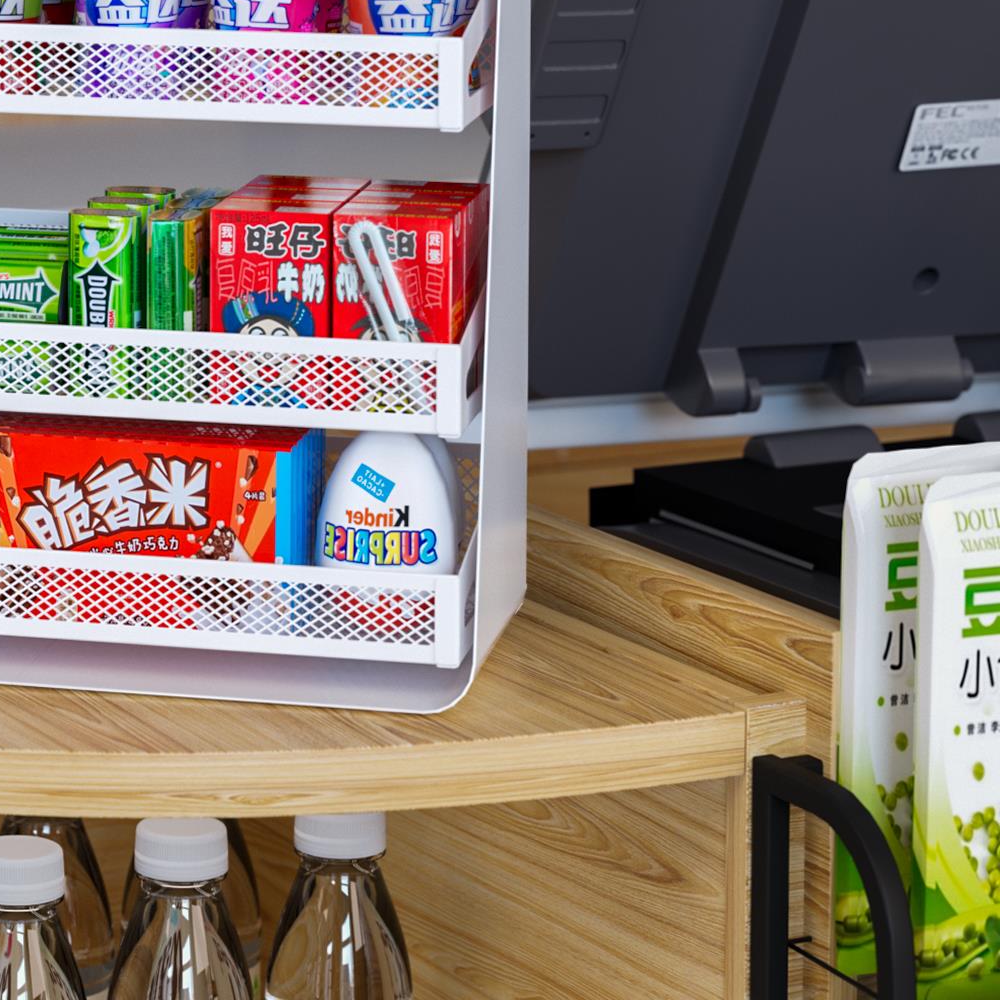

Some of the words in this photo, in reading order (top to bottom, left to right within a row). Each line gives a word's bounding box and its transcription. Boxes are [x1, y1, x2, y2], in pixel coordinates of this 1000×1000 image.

[245, 222, 326, 259] 旺仔
[87, 274, 109, 327] DOUB
[276, 260, 326, 304] 牛奶
[17, 453, 211, 549] 脆香米
[90, 535, 179, 555] 牛奶巧克力
